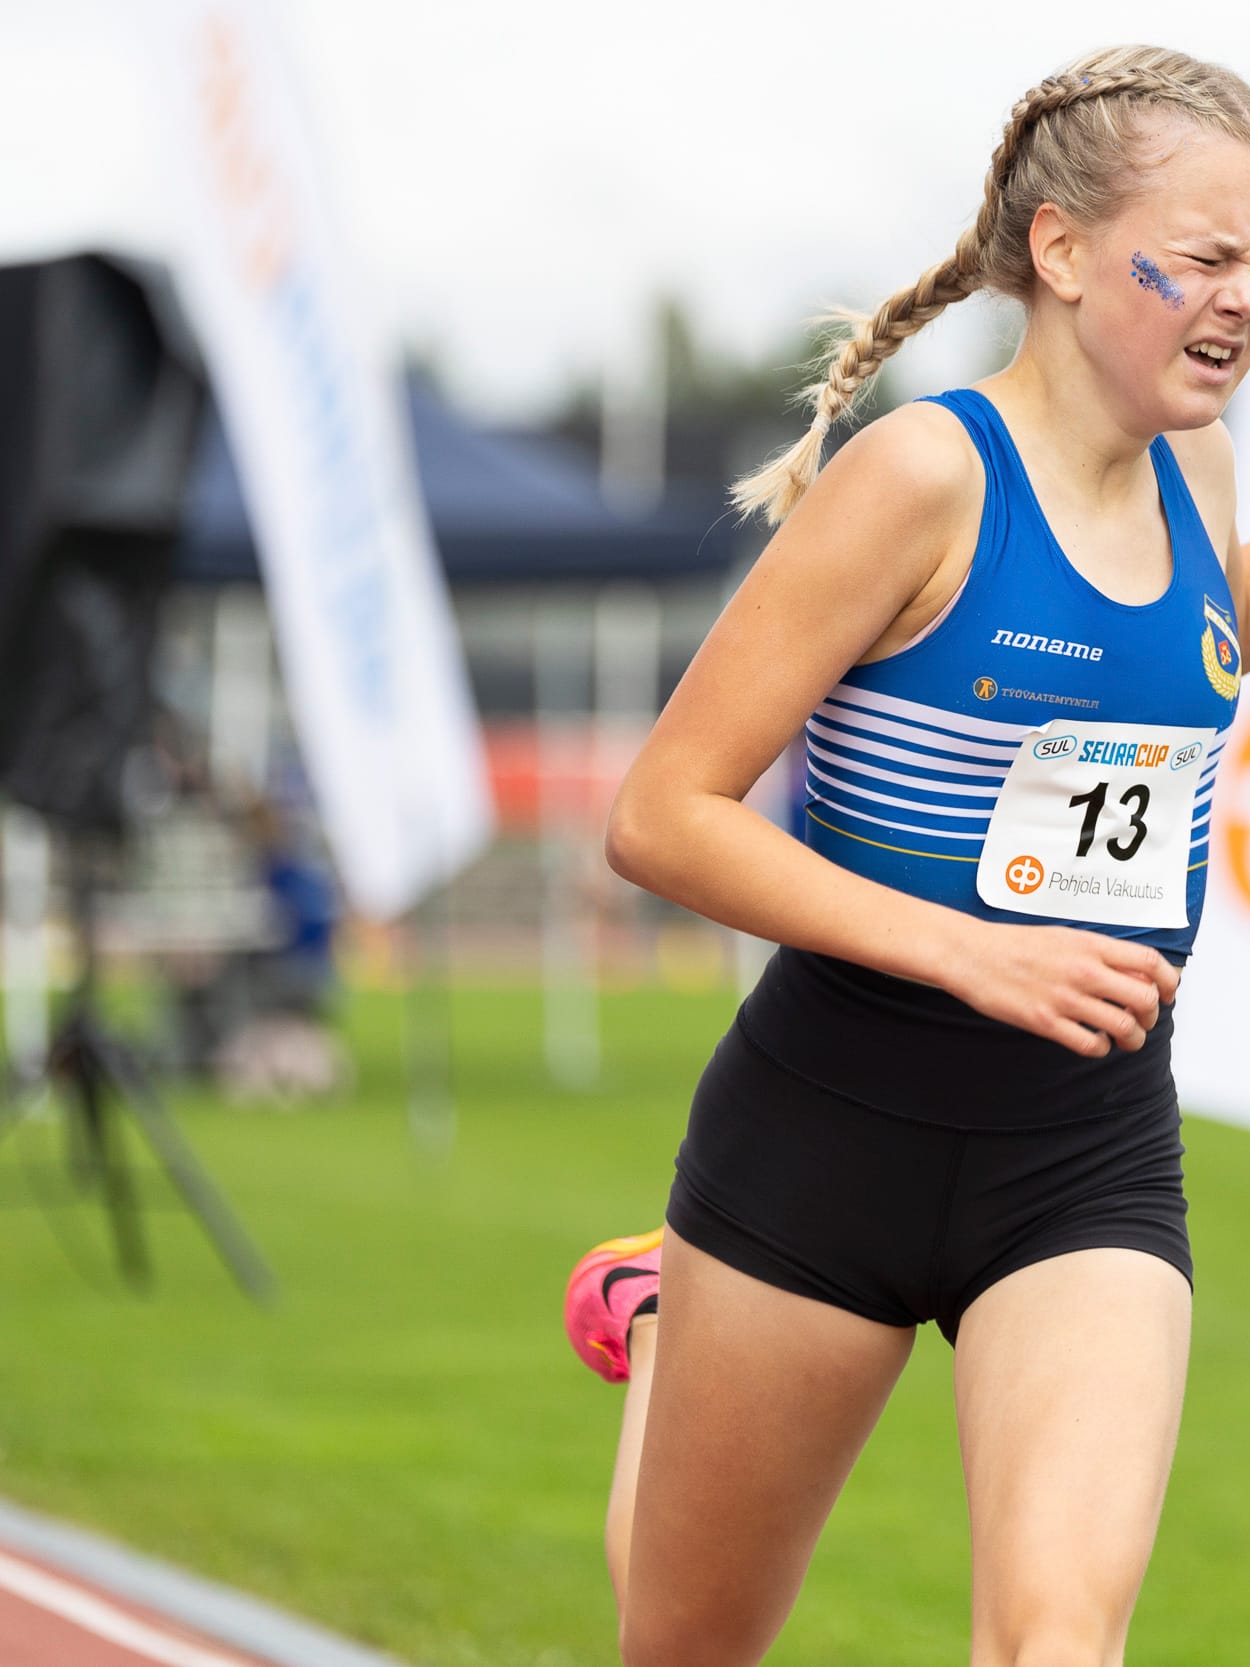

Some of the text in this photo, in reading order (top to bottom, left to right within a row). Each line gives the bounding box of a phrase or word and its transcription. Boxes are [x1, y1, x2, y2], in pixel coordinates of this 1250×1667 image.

[990, 629, 1104, 661] noname
[1041, 739, 1196, 767] SUL SEURACUP SUL
[1069, 782, 1151, 861] 13
[1049, 872, 1101, 897] Pohjola
[1106, 877, 1164, 900] Vakuutus
